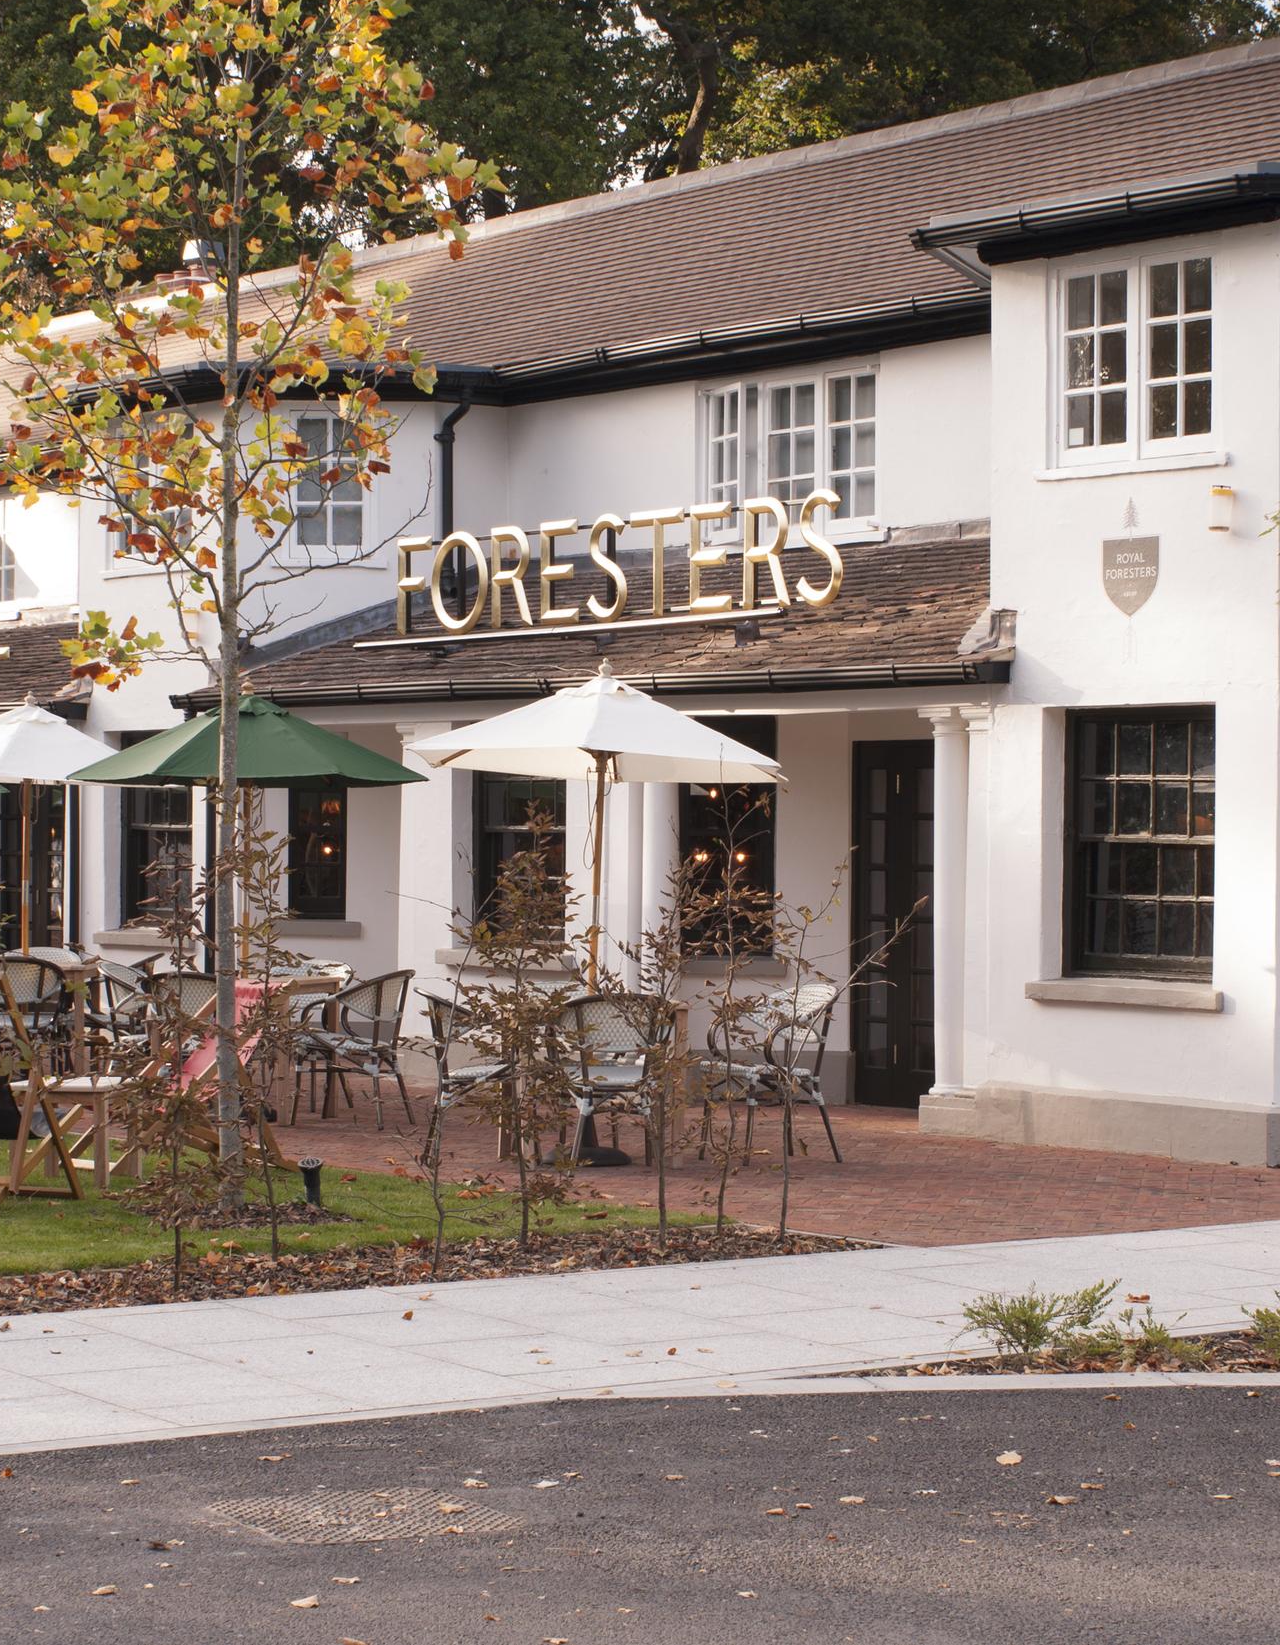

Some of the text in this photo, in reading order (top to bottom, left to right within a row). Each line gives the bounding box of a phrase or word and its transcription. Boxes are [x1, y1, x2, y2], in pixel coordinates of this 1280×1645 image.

[396, 488, 844, 636] FORESTERS
[1116, 553, 1145, 564] ROYAL
[1105, 566, 1157, 580] FORESTERS
